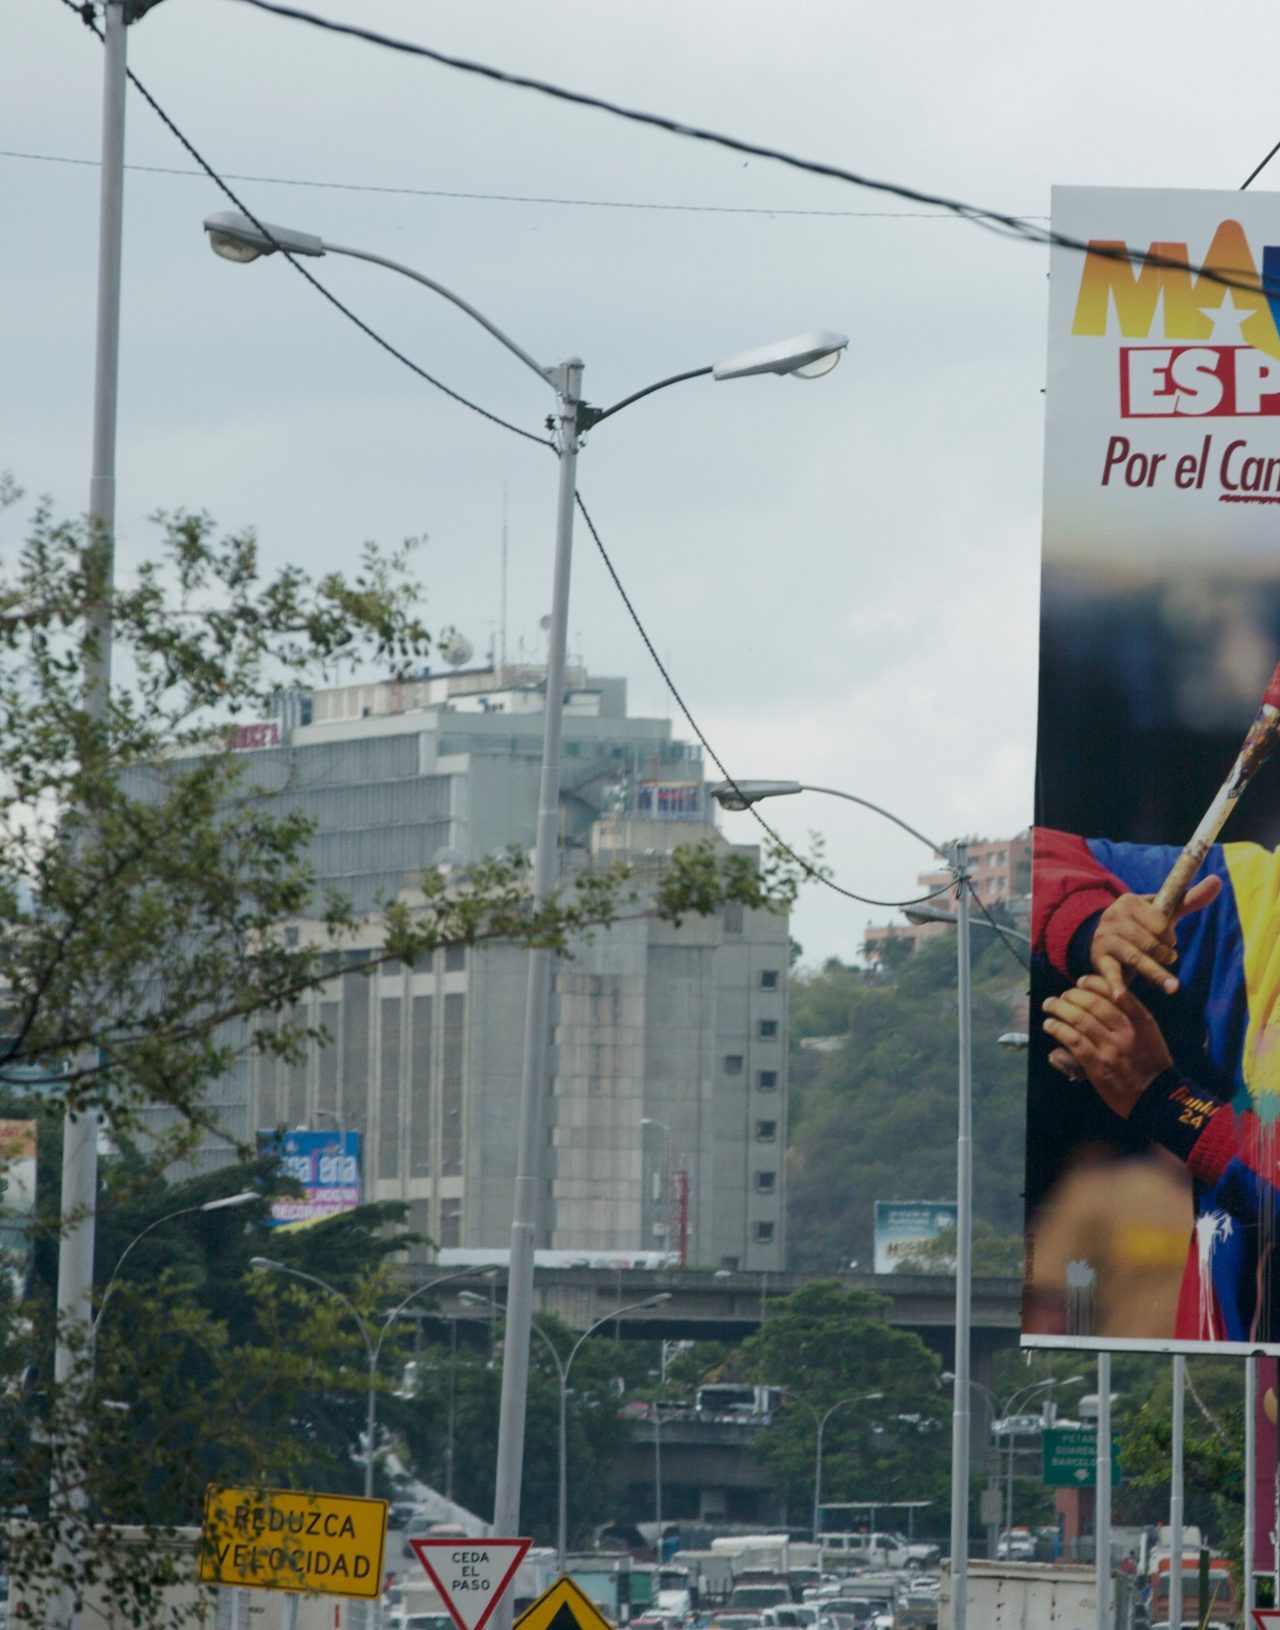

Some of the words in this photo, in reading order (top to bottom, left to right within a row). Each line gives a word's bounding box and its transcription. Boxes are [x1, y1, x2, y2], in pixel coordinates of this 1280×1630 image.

[1128, 349, 1224, 416] ES
[1101, 435, 1167, 488] Por
[1174, 434, 1212, 489] el
[233, 1505, 356, 1539] REDUZCA
[215, 1543, 371, 1578] VELOCIDAD
[452, 1552, 490, 1563] CEDA
[462, 1566, 480, 1577] EL
[452, 1580, 490, 1591] PASO
